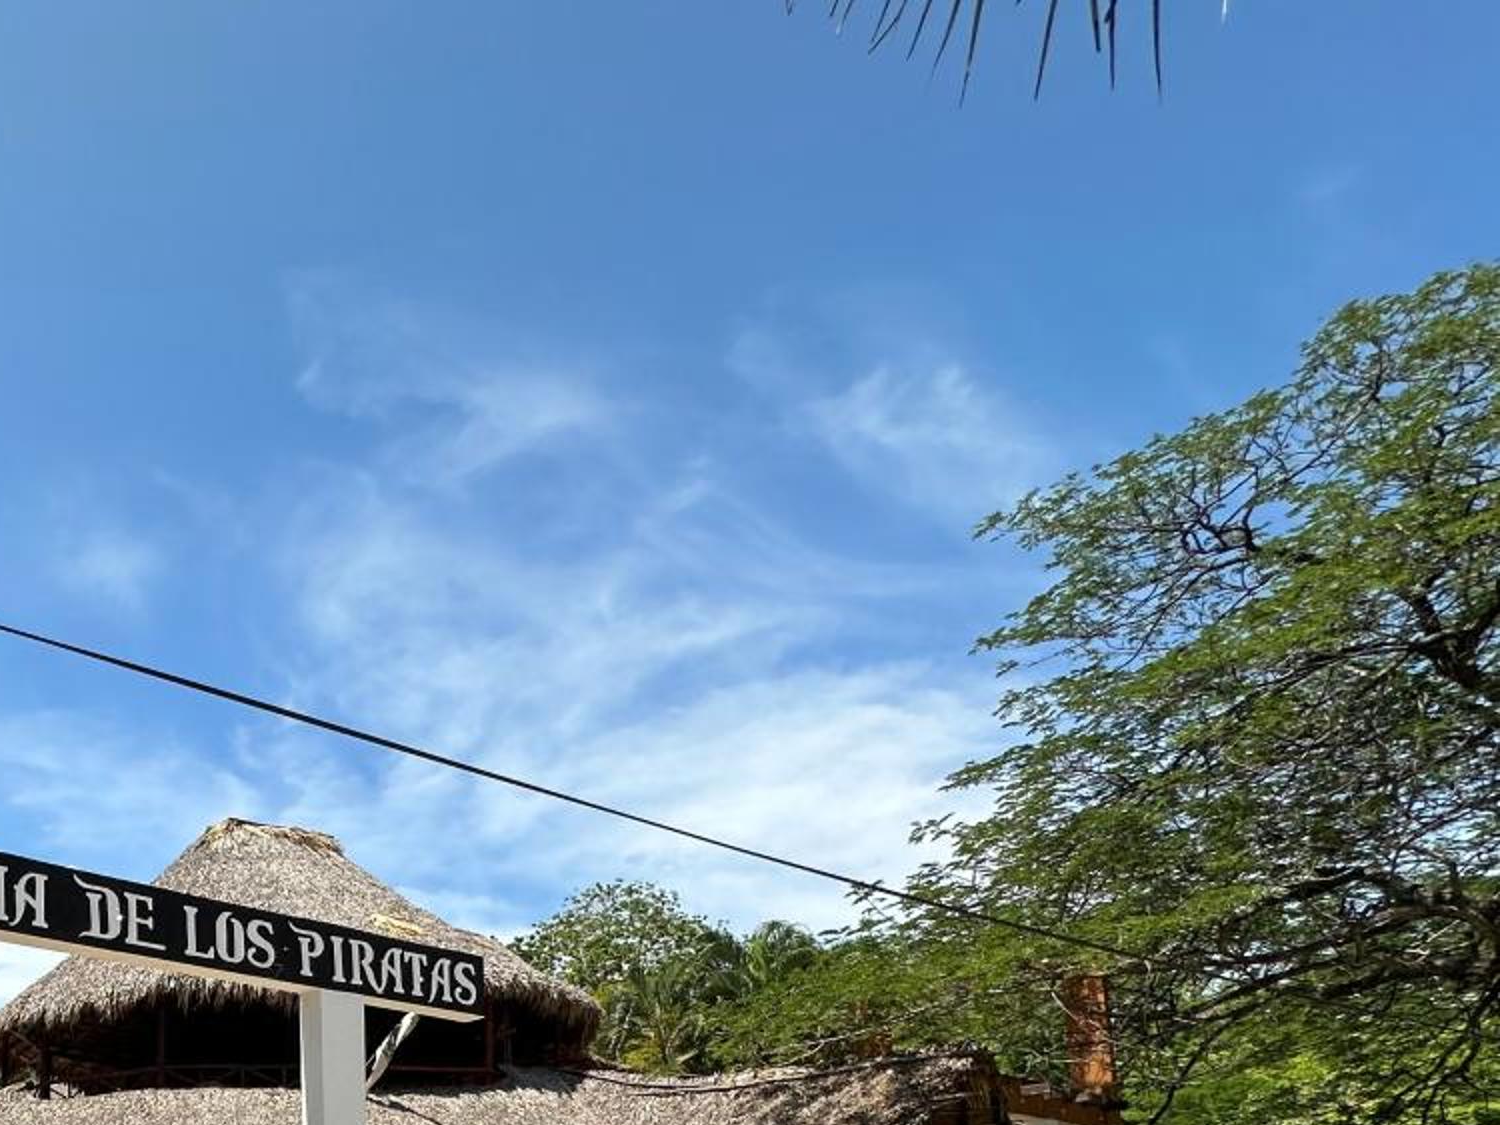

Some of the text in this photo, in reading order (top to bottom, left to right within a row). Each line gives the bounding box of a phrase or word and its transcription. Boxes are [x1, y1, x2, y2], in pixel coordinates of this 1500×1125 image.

[74, 874, 167, 950] DE
[185, 905, 276, 969] LOS
[289, 922, 478, 1006] PIRATAS
